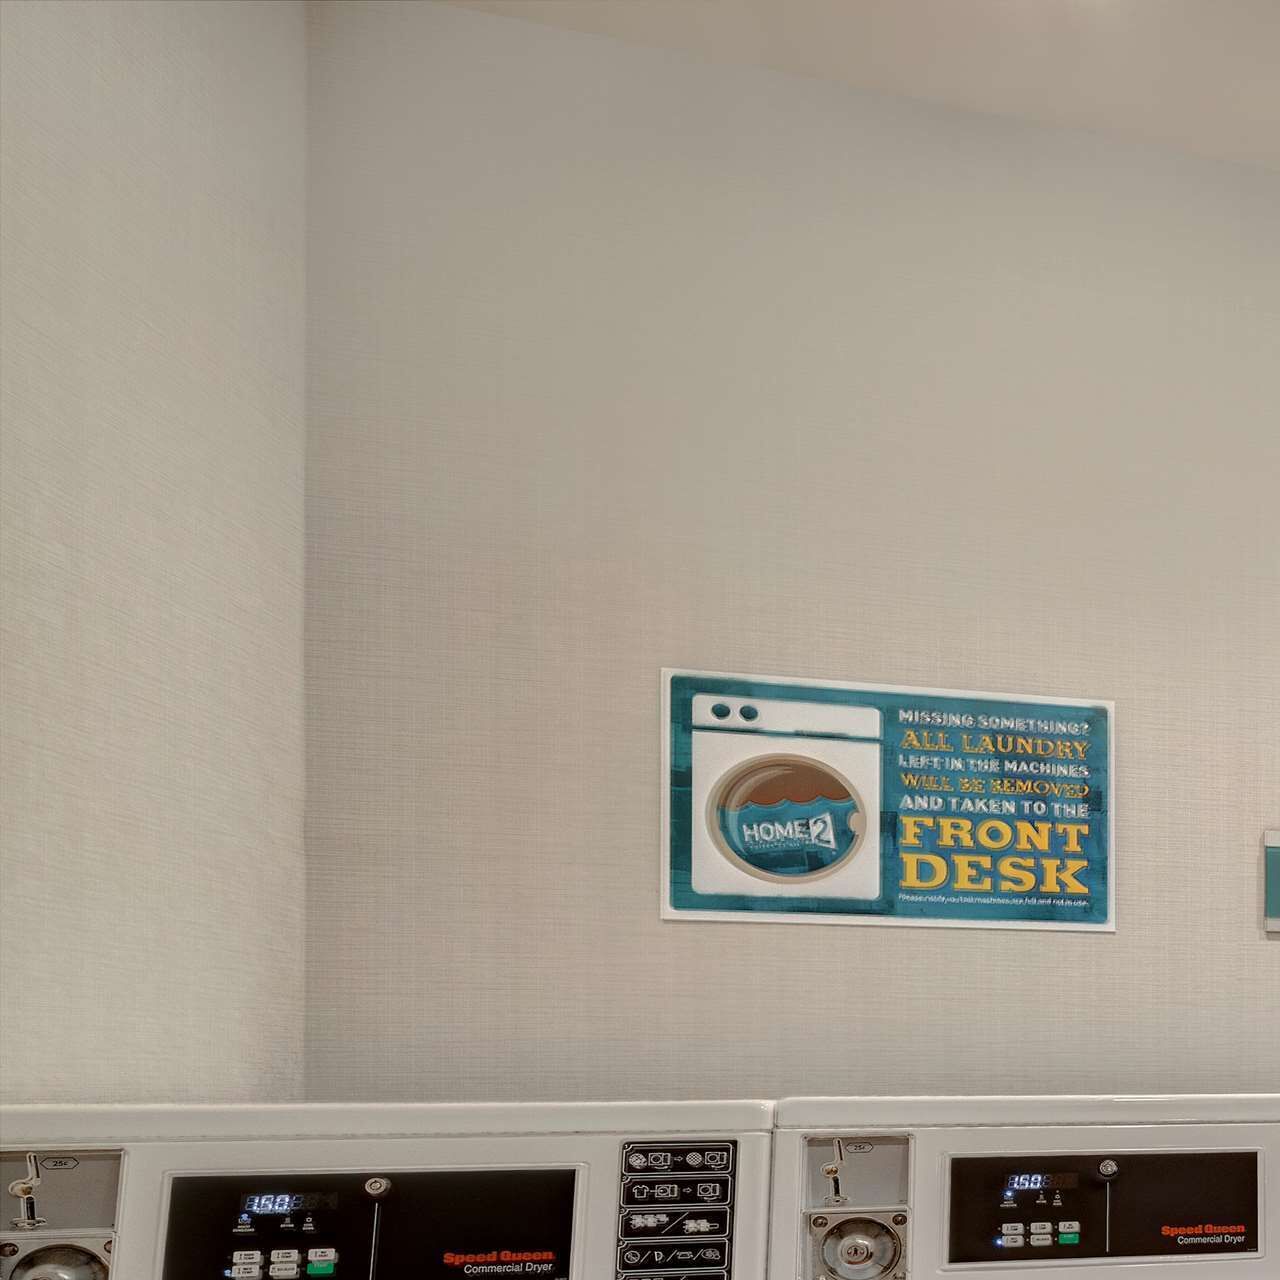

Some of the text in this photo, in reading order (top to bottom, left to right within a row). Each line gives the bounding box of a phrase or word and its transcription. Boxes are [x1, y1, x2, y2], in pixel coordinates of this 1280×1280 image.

[899, 709, 1090, 736] MISSING SOMETHING?
[901, 728, 1091, 760] ALL LAUNDRY
[899, 754, 1091, 778] LEFT IN THE MACHINES
[902, 772, 1089, 799] WILL BE REMOVED
[900, 794, 1089, 819] AND TAKEN TO THE
[900, 815, 1089, 853] FRONT
[899, 852, 1090, 895] DESK
[1161, 1224, 1246, 1237] Speed Queen
[1177, 1234, 1245, 1245] Commercial Dryer
[443, 1250, 554, 1265] Speed Queen
[464, 1262, 553, 1274] Commercial Dryer
